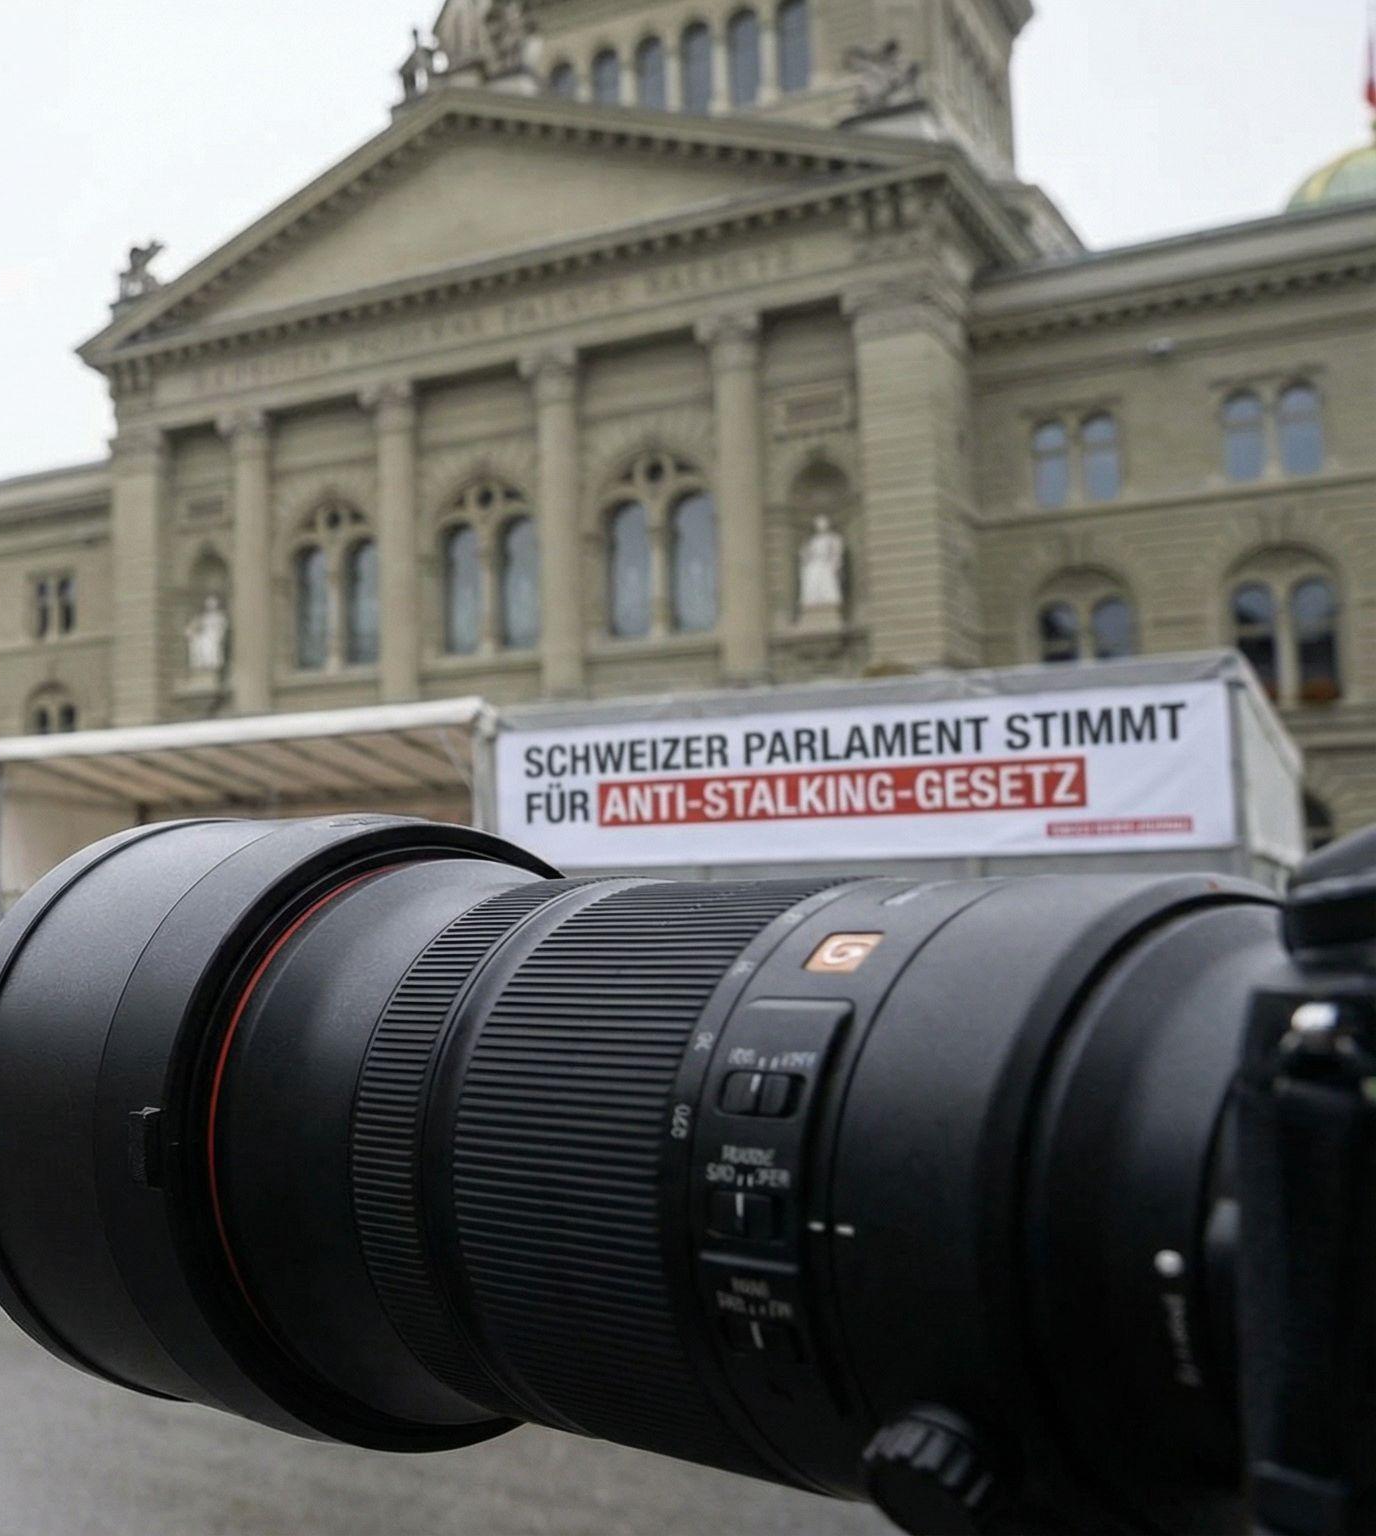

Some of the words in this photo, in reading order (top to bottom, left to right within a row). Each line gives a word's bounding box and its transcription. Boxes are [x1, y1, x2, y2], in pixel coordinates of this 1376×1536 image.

[524, 734, 729, 778] SCHWEIZER
[744, 716, 988, 766] PARLAMENT
[1005, 702, 1186, 750] STIMMT
[526, 783, 590, 824] FÜR
[603, 761, 1080, 822] ANTI-STALKING-GESETZ
